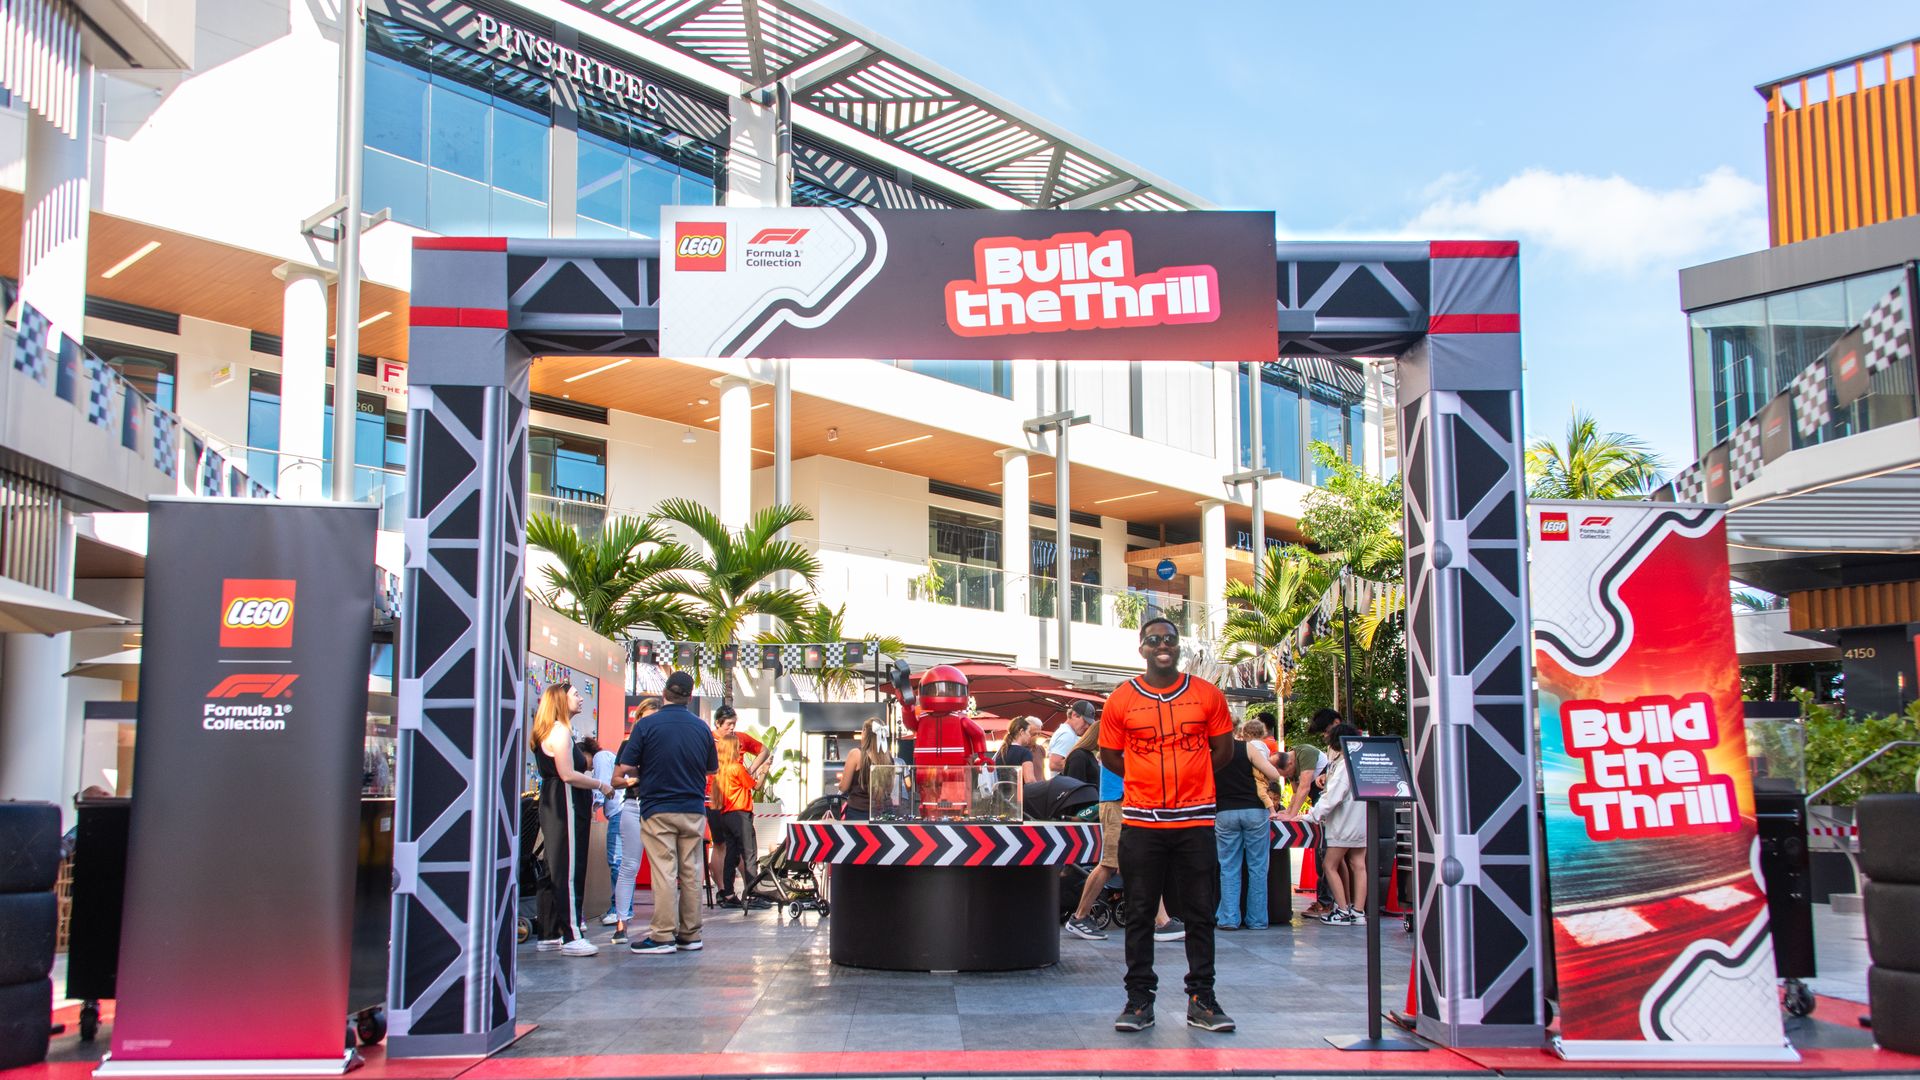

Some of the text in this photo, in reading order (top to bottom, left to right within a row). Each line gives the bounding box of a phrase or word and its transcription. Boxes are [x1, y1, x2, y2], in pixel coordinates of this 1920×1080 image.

[477, 12, 659, 110] PINSTRIPES
[678, 236, 724, 257] LEGO
[746, 249, 792, 258] Formula
[746, 258, 802, 267] Collection
[984, 239, 1125, 286] Build
[381, 385, 401, 394] THE
[1542, 521, 1567, 532] LEGO
[226, 599, 291, 626] LEGO
[1844, 647, 1876, 659] 4150
[203, 704, 272, 717] Formula
[203, 717, 286, 730] Collection
[1569, 702, 1710, 748] Build
[1591, 748, 1701, 788] the
[1578, 783, 1732, 831] Thrill
